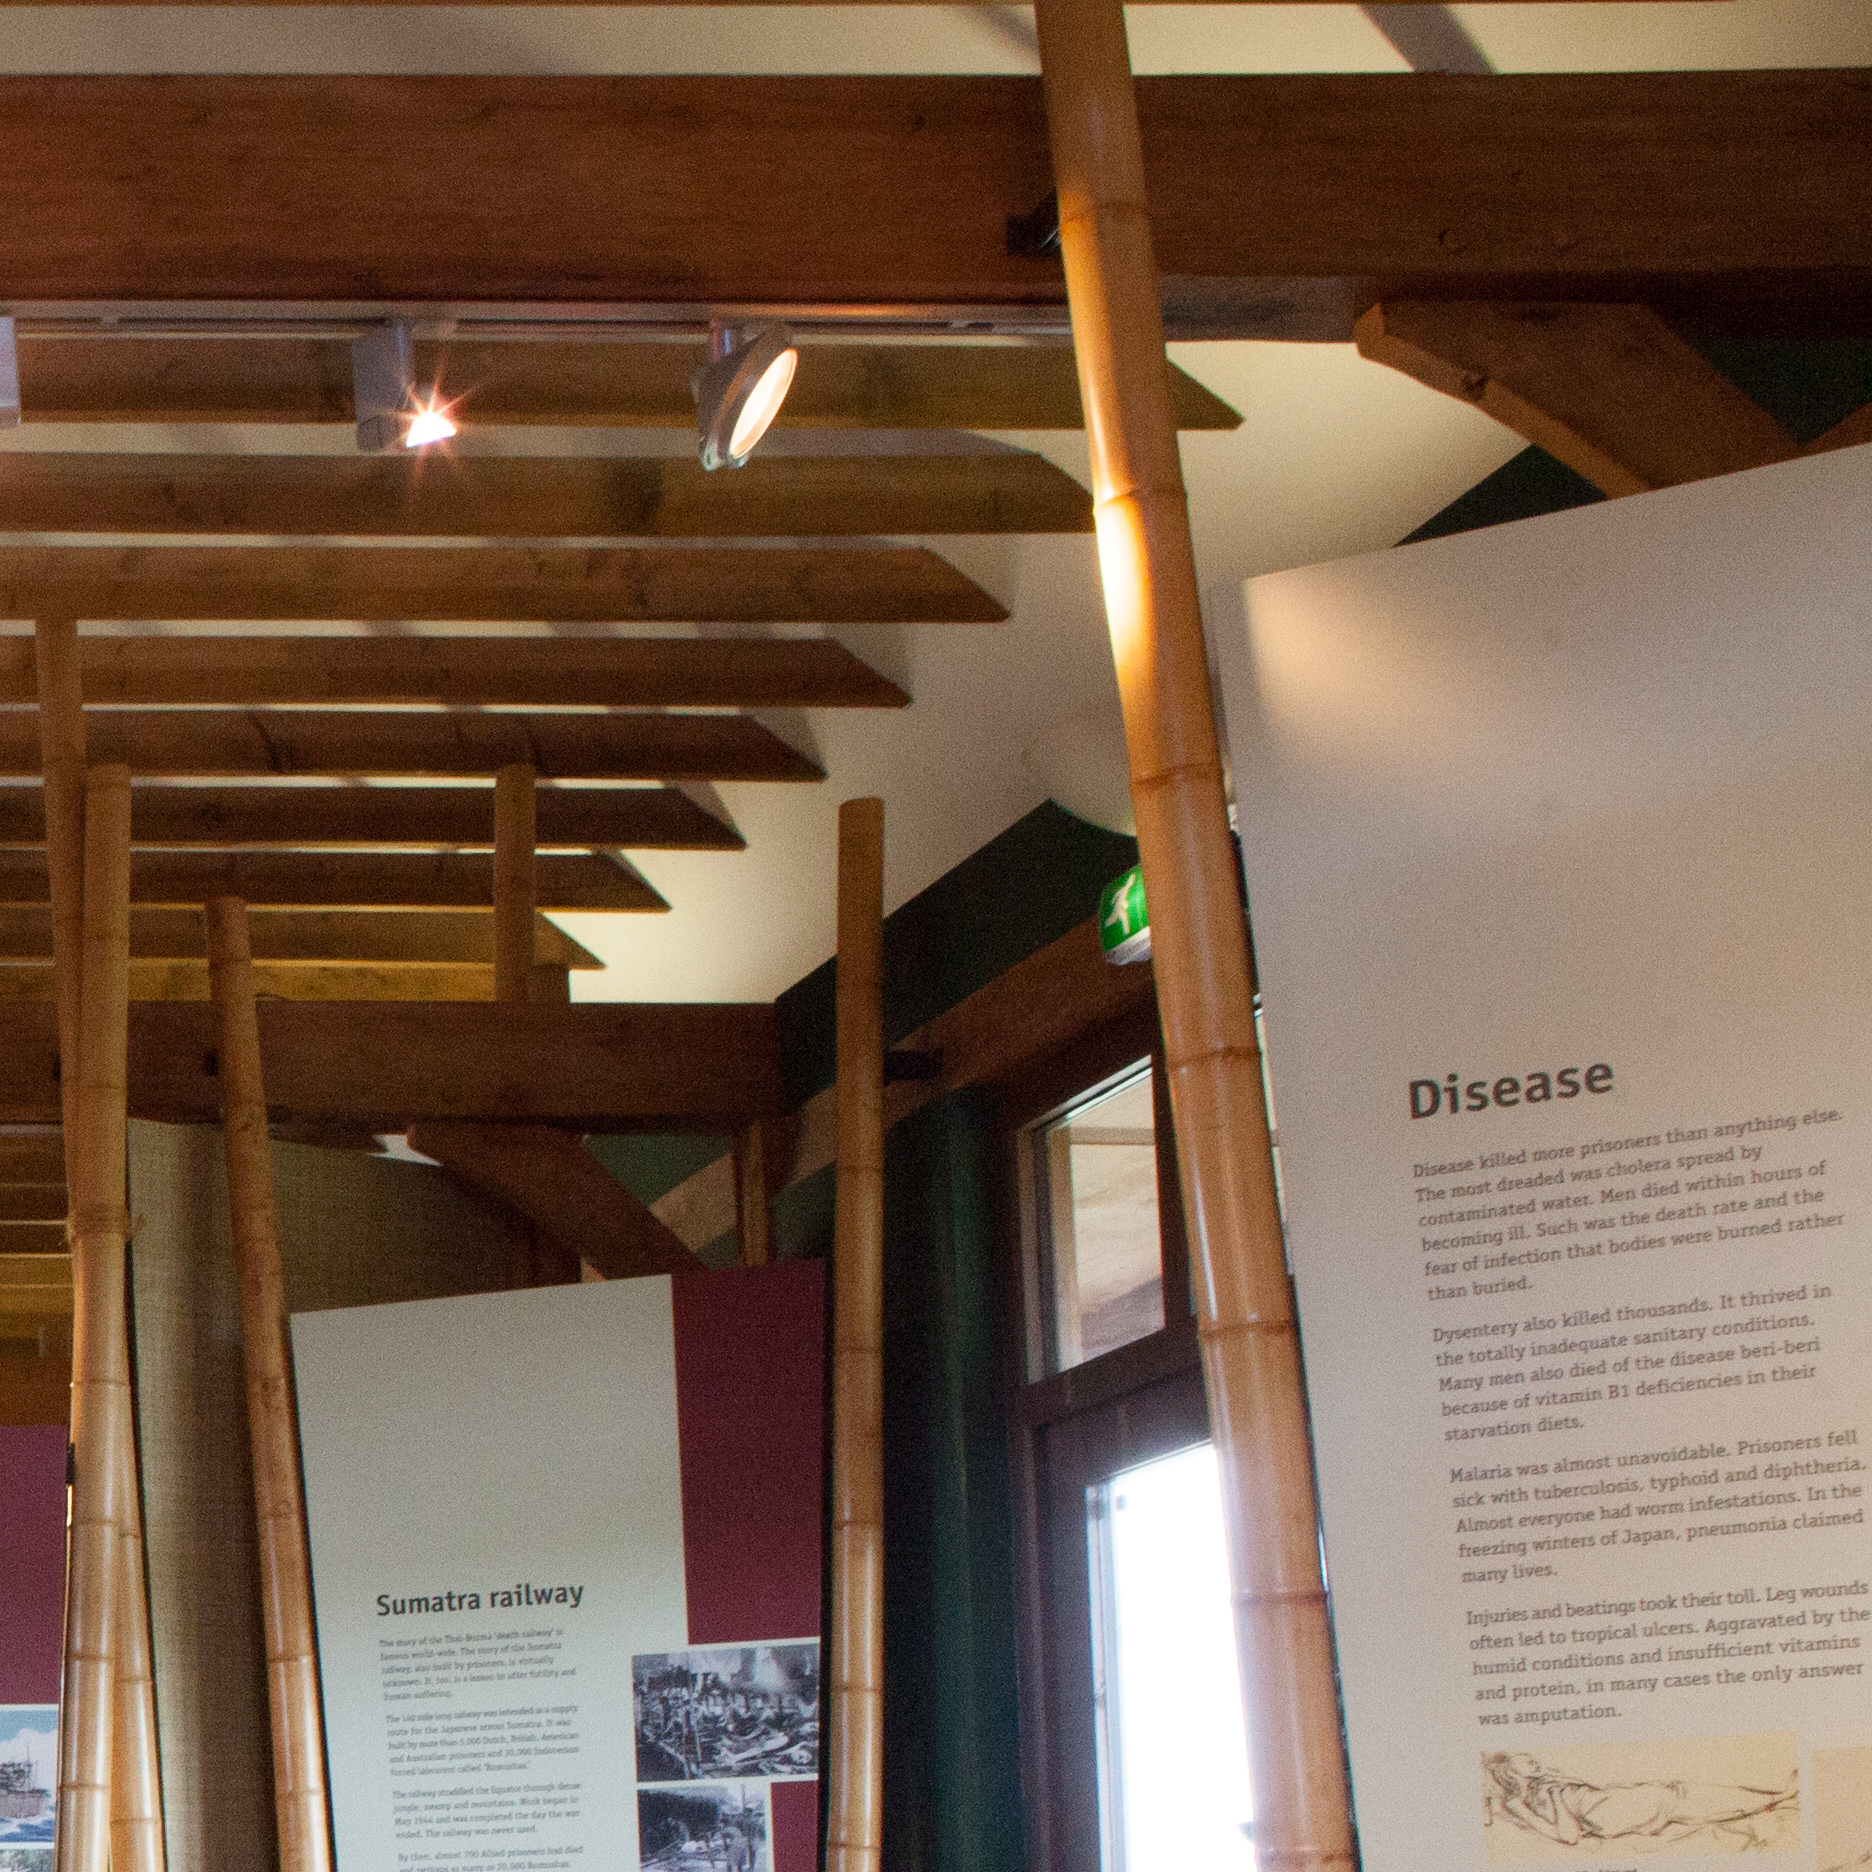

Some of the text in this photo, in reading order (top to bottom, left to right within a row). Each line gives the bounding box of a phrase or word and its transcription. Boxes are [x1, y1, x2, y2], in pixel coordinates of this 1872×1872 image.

[1409, 1062, 1614, 1119] Disease
[1412, 1109, 1842, 1179] Disease killed more prisoners than anything else.
[1414, 1145, 1763, 1203] The most dreaded was cholera spread by
[1418, 1159, 1827, 1228] contaminated water. Men died within hours of
[376, 1582, 584, 1617] Sumatra railway
